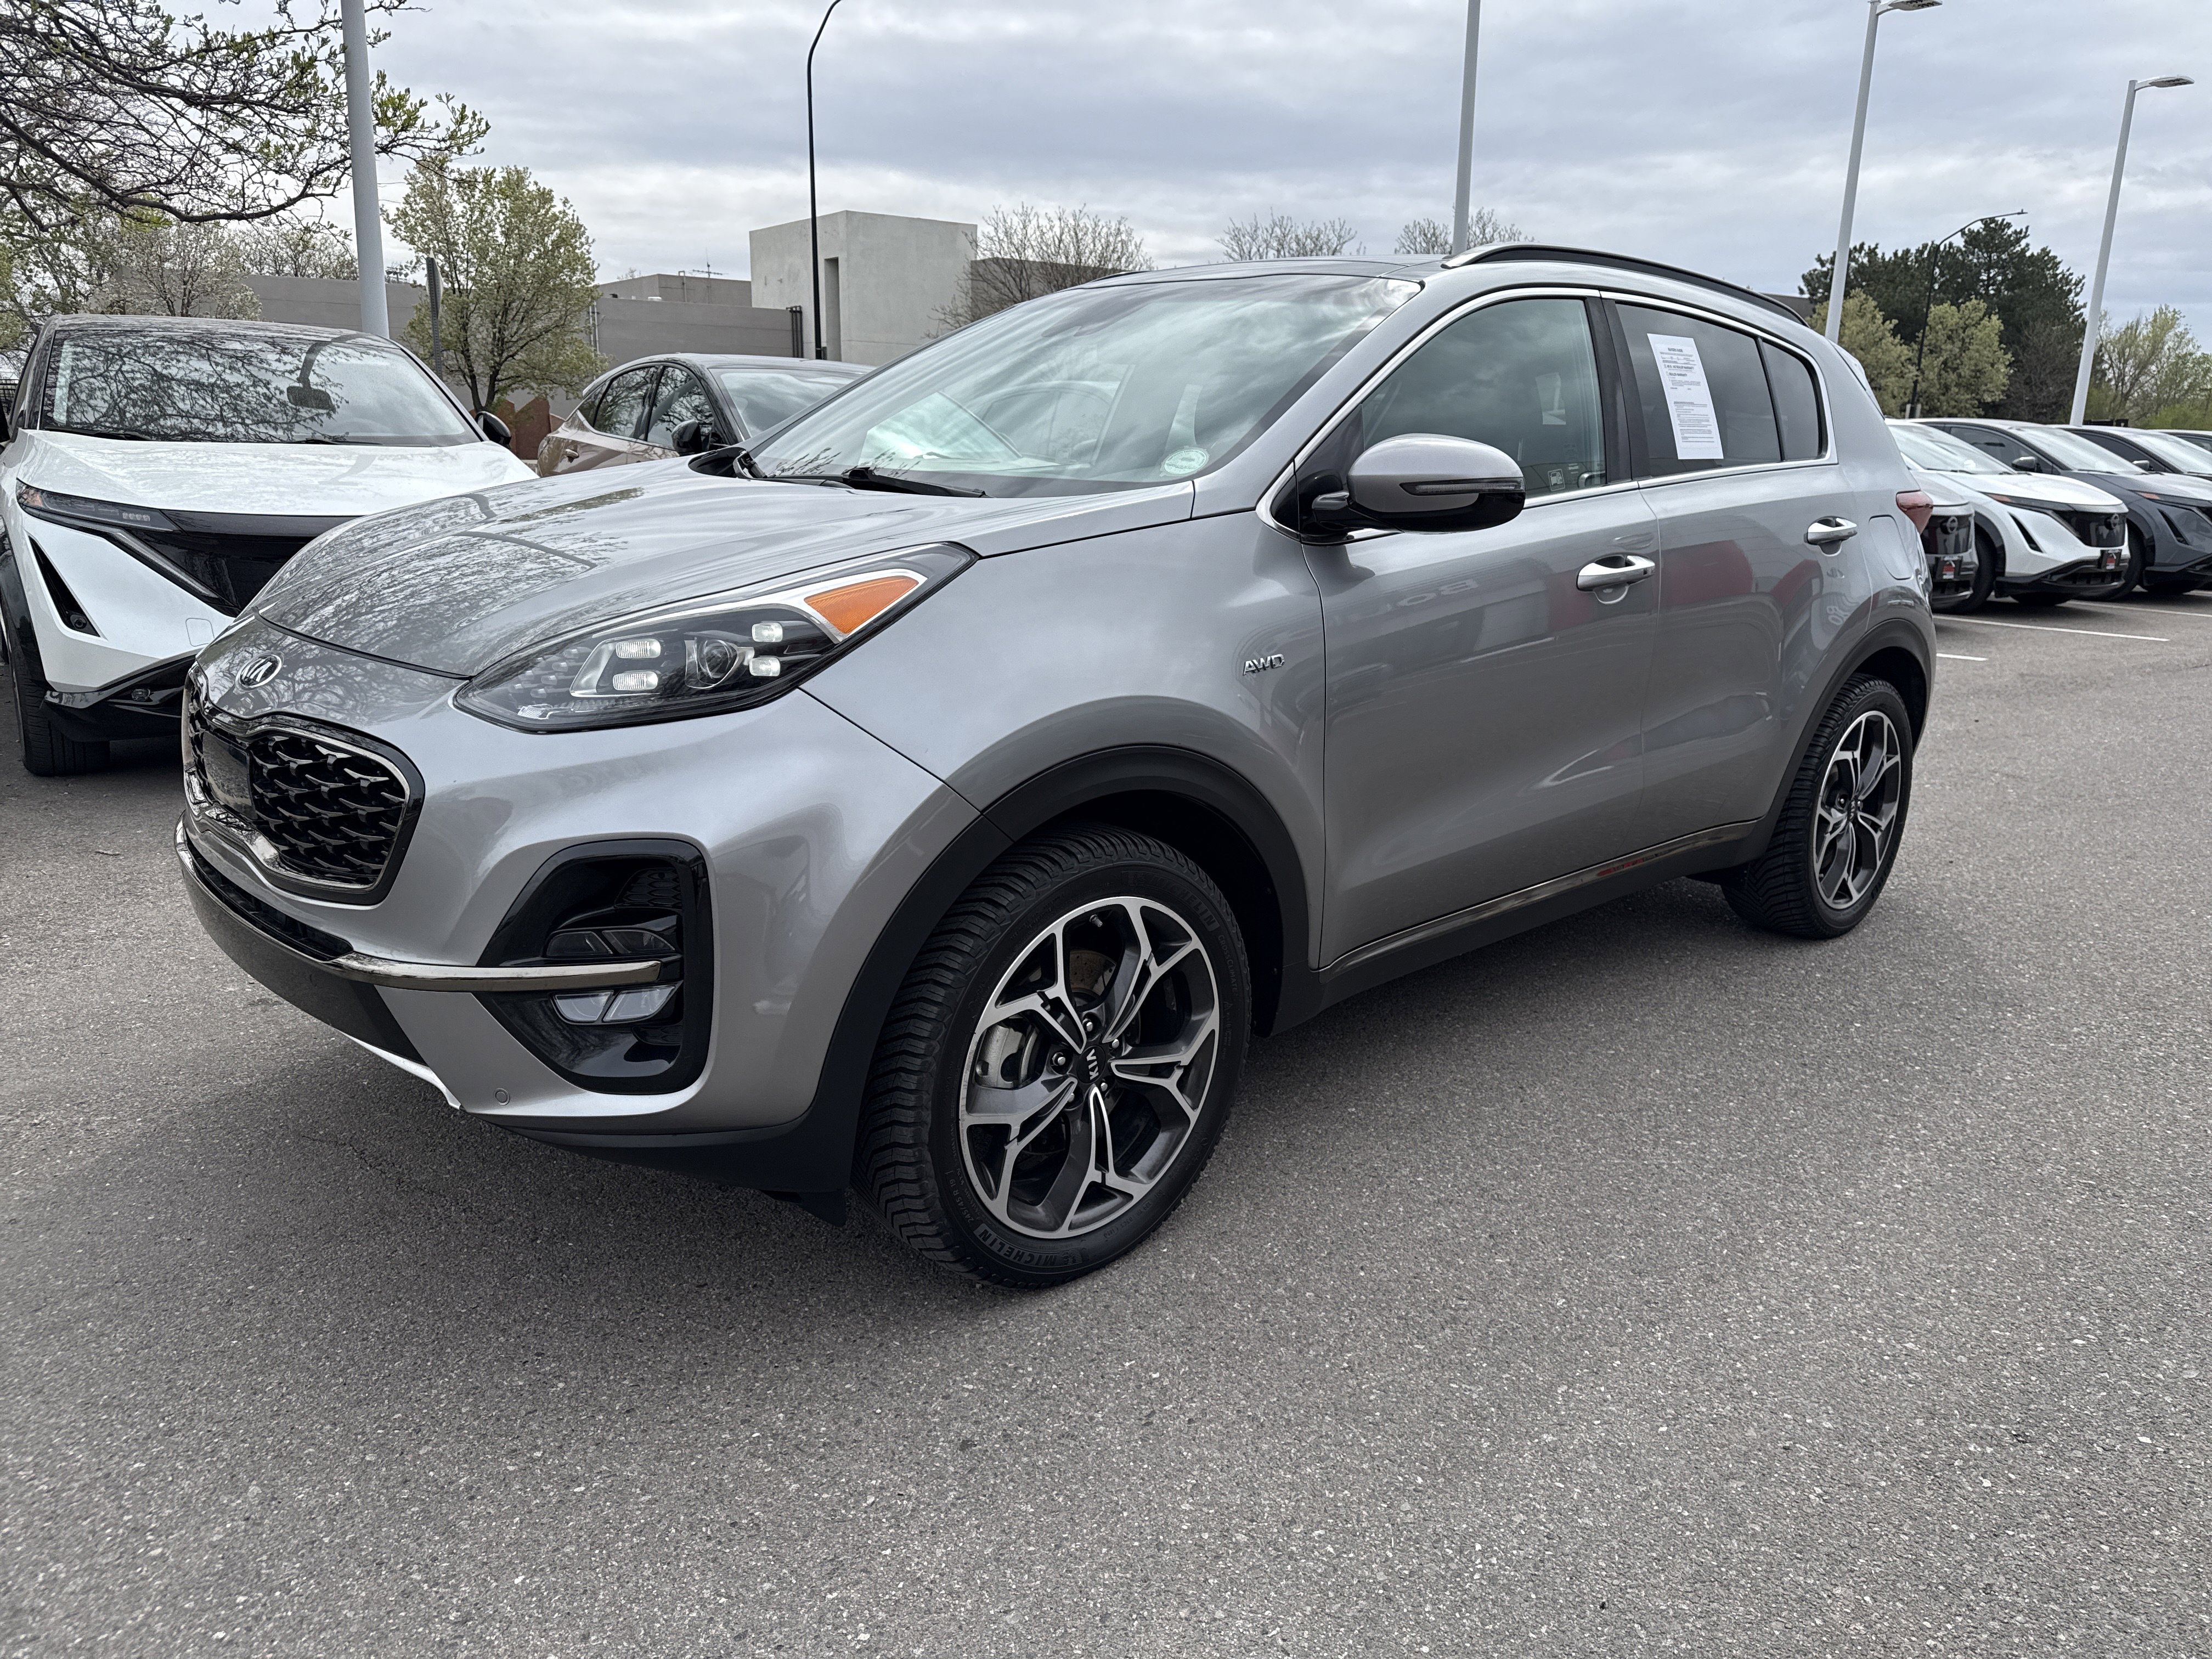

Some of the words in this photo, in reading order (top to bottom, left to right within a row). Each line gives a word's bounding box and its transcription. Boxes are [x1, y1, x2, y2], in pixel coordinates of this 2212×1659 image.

[1243, 653, 1285, 676] AWD
[1086, 1048, 1099, 1080] KIA
[949, 1179, 956, 1188] 19
[956, 1196, 975, 1223] 245/45
[979, 1228, 1058, 1266] MICHELIN
